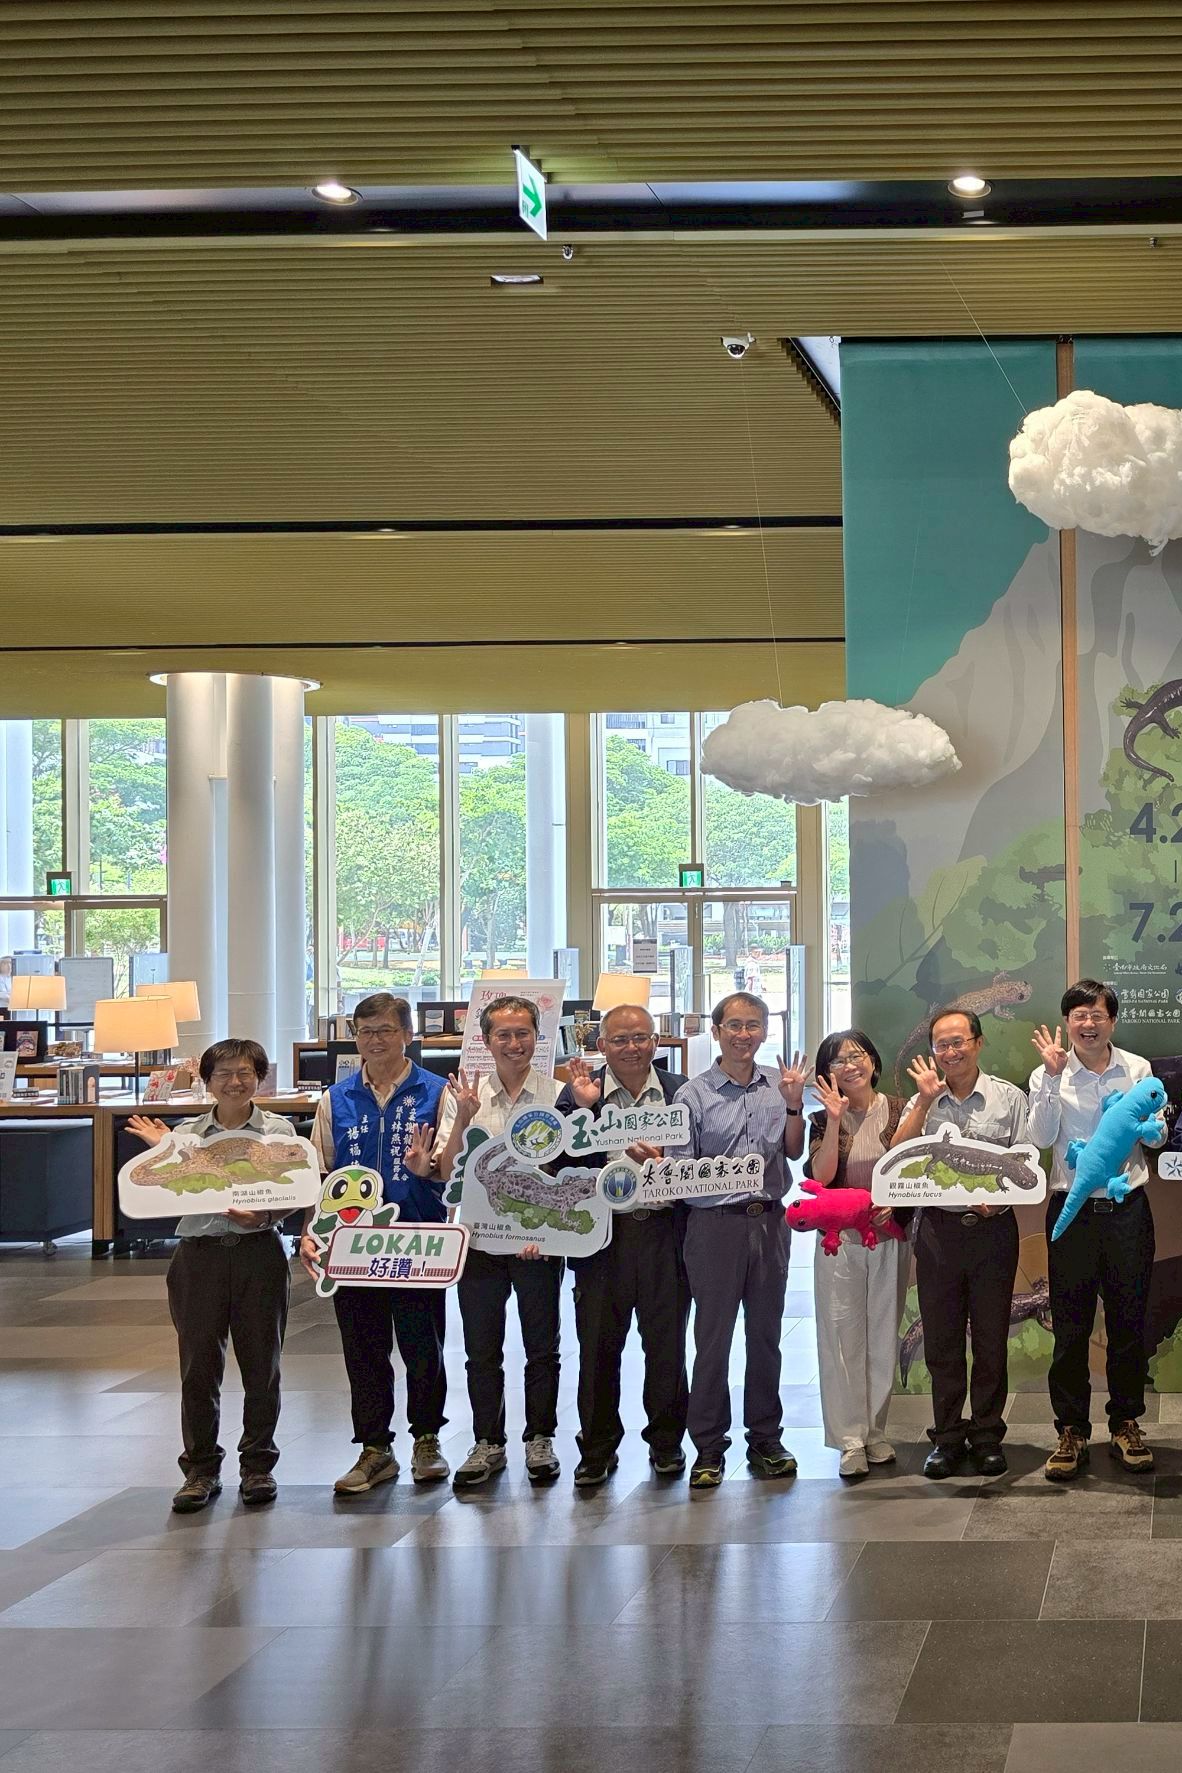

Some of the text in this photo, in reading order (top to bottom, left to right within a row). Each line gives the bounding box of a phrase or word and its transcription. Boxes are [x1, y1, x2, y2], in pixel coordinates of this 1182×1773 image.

[571, 1110, 683, 1150] 玉山國家公園
[595, 1132, 683, 1147] Yushan National Park
[643, 1159, 760, 1187] 太魯閣國家公園
[643, 1178, 759, 1199] TAROKO NATIONAL PARK
[888, 1190, 942, 1199] Hynobius fucus
[232, 1194, 296, 1205] Hynobius glacialis
[473, 1222, 512, 1232] 臺灣山椒魚
[471, 1231, 546, 1243] Hynobius formosanus
[350, 1233, 445, 1257] LOKAH
